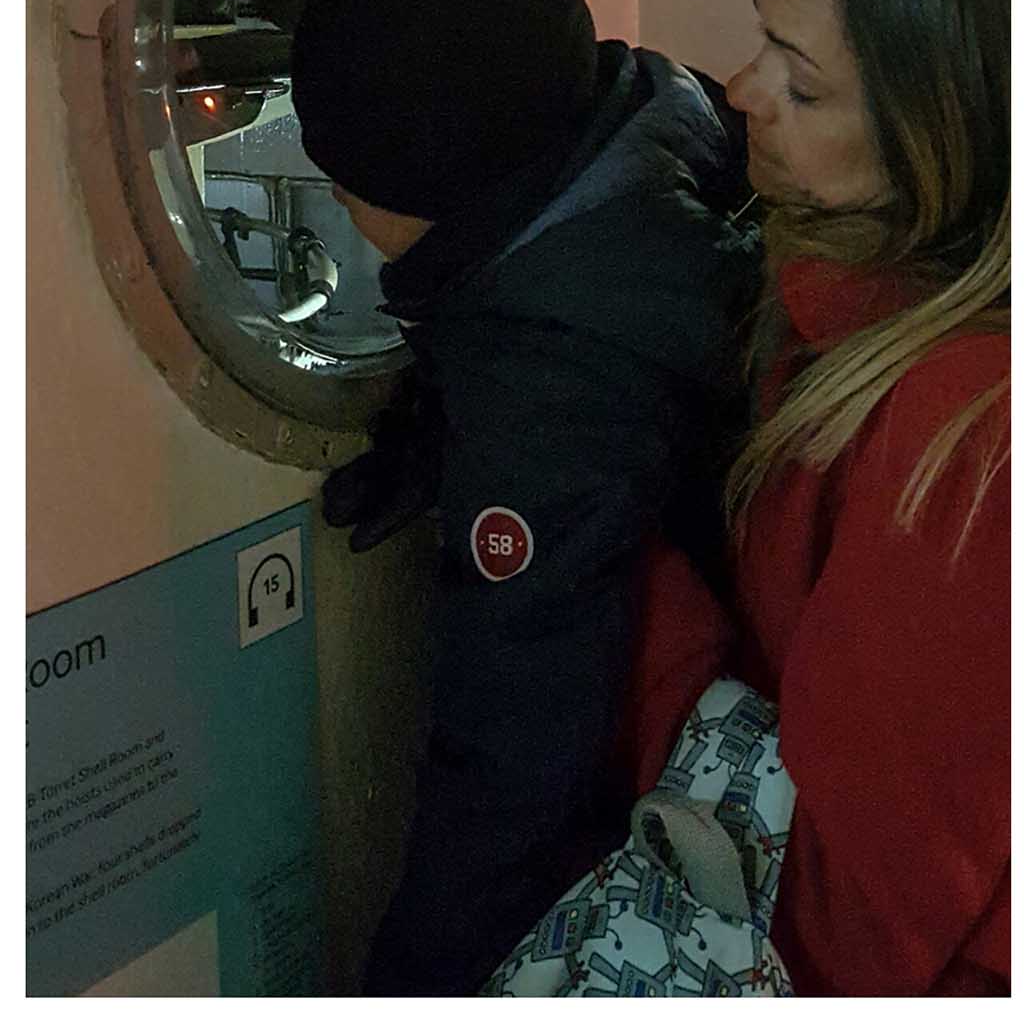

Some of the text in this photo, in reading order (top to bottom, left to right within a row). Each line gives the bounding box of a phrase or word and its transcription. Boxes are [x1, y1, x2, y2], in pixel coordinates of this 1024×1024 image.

[487, 533, 514, 556] 58
[263, 573, 279, 596] 15
[26, 635, 106, 688] oom
